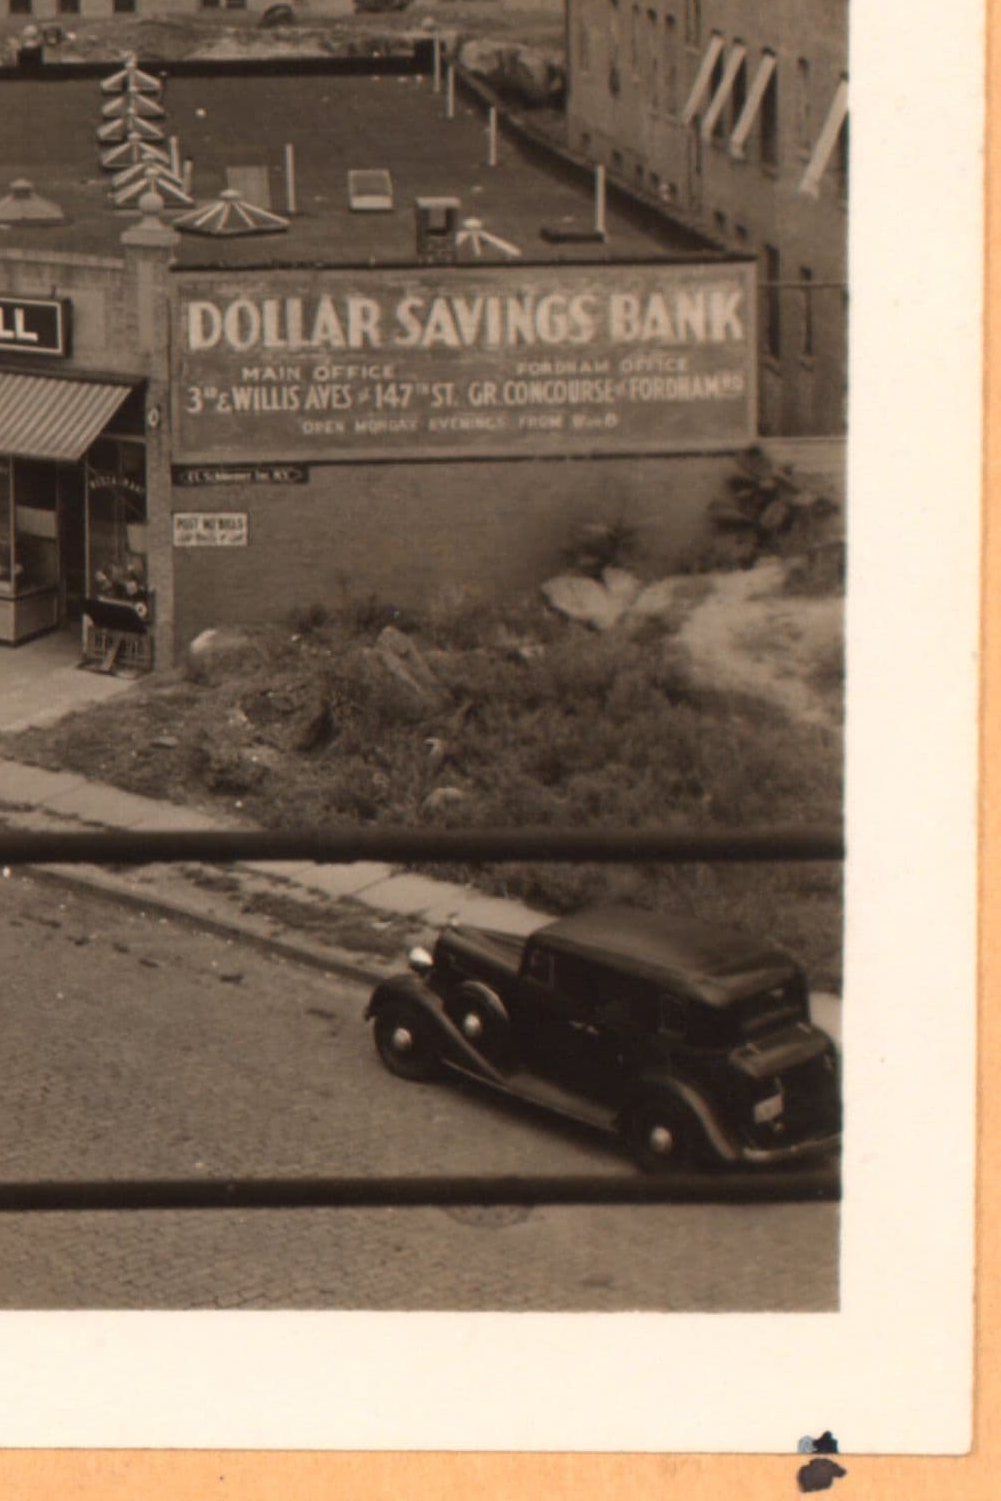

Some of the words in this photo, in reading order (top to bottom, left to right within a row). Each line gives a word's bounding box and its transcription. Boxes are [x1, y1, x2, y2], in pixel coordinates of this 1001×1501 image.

[187, 298, 382, 350] DOLLAR
[395, 296, 598, 347] SAVINGS
[610, 292, 743, 341] BANK
[241, 366, 299, 381] MAIN
[312, 365, 396, 381] OFFICE
[516, 360, 609, 375] FORDHAM
[620, 357, 687, 373] OFFICE
[231, 385, 300, 411] WILLIS
[304, 383, 352, 410] AVES
[503, 378, 615, 405] CONCOURSE
[629, 374, 719, 401] FORDHAM
[518, 414, 563, 429] FROM
